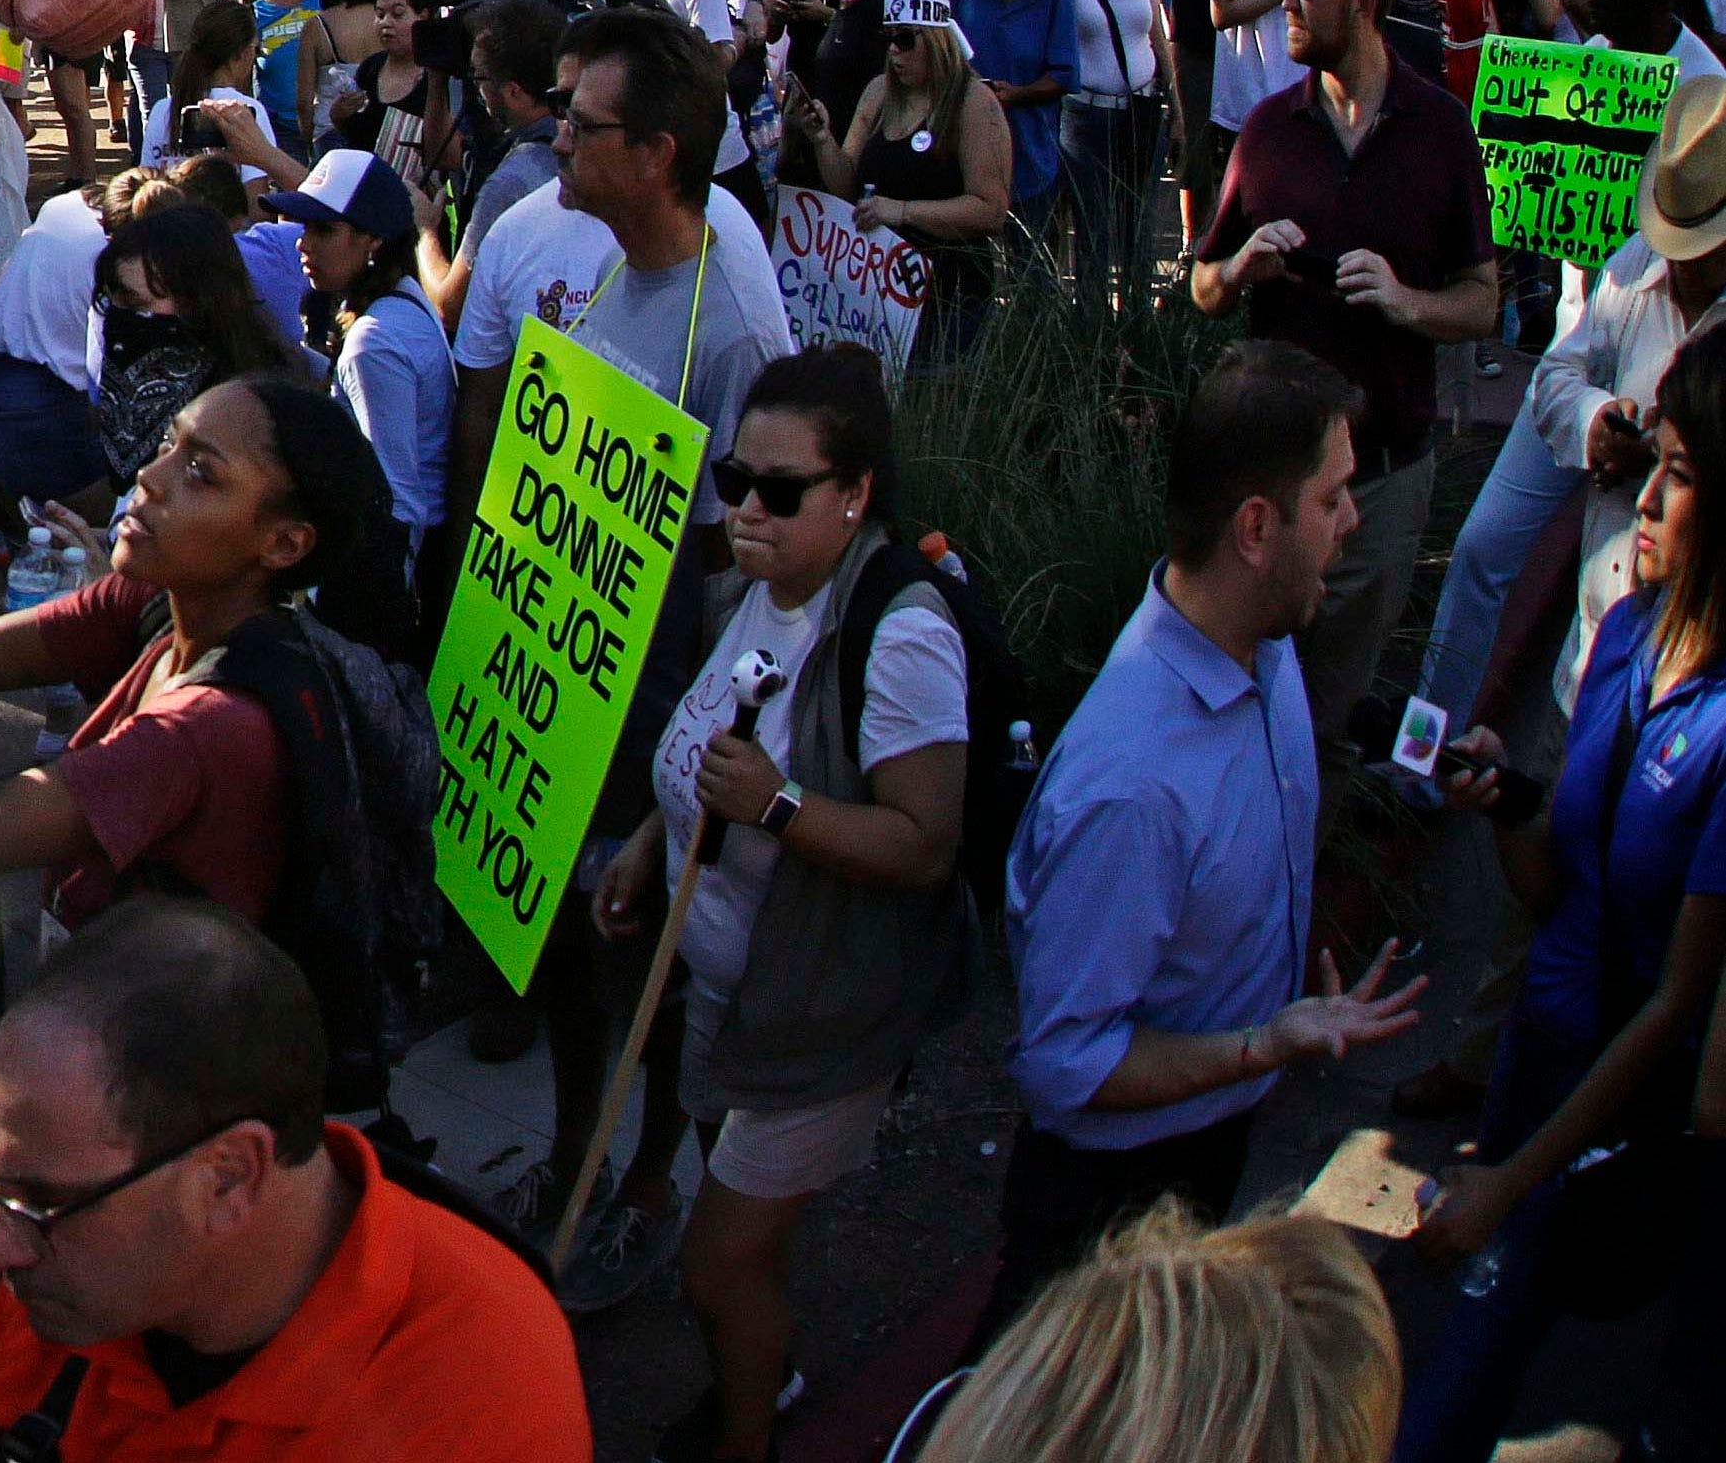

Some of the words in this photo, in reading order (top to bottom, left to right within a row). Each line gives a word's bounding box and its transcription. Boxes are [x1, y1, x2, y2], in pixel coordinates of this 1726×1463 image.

[1579, 54, 1676, 98] Seeking
[1611, 88, 1666, 125] Stat
[515, 372, 569, 457] GO
[575, 415, 688, 554] HOME
[467, 522, 553, 631] TAKE
[548, 596, 626, 702] JOE
[509, 462, 646, 619] DONNIE
[444, 683, 551, 831] HATE
[484, 631, 560, 735] AND
[433, 756, 479, 844] TH
[477, 808, 547, 926] YOU
